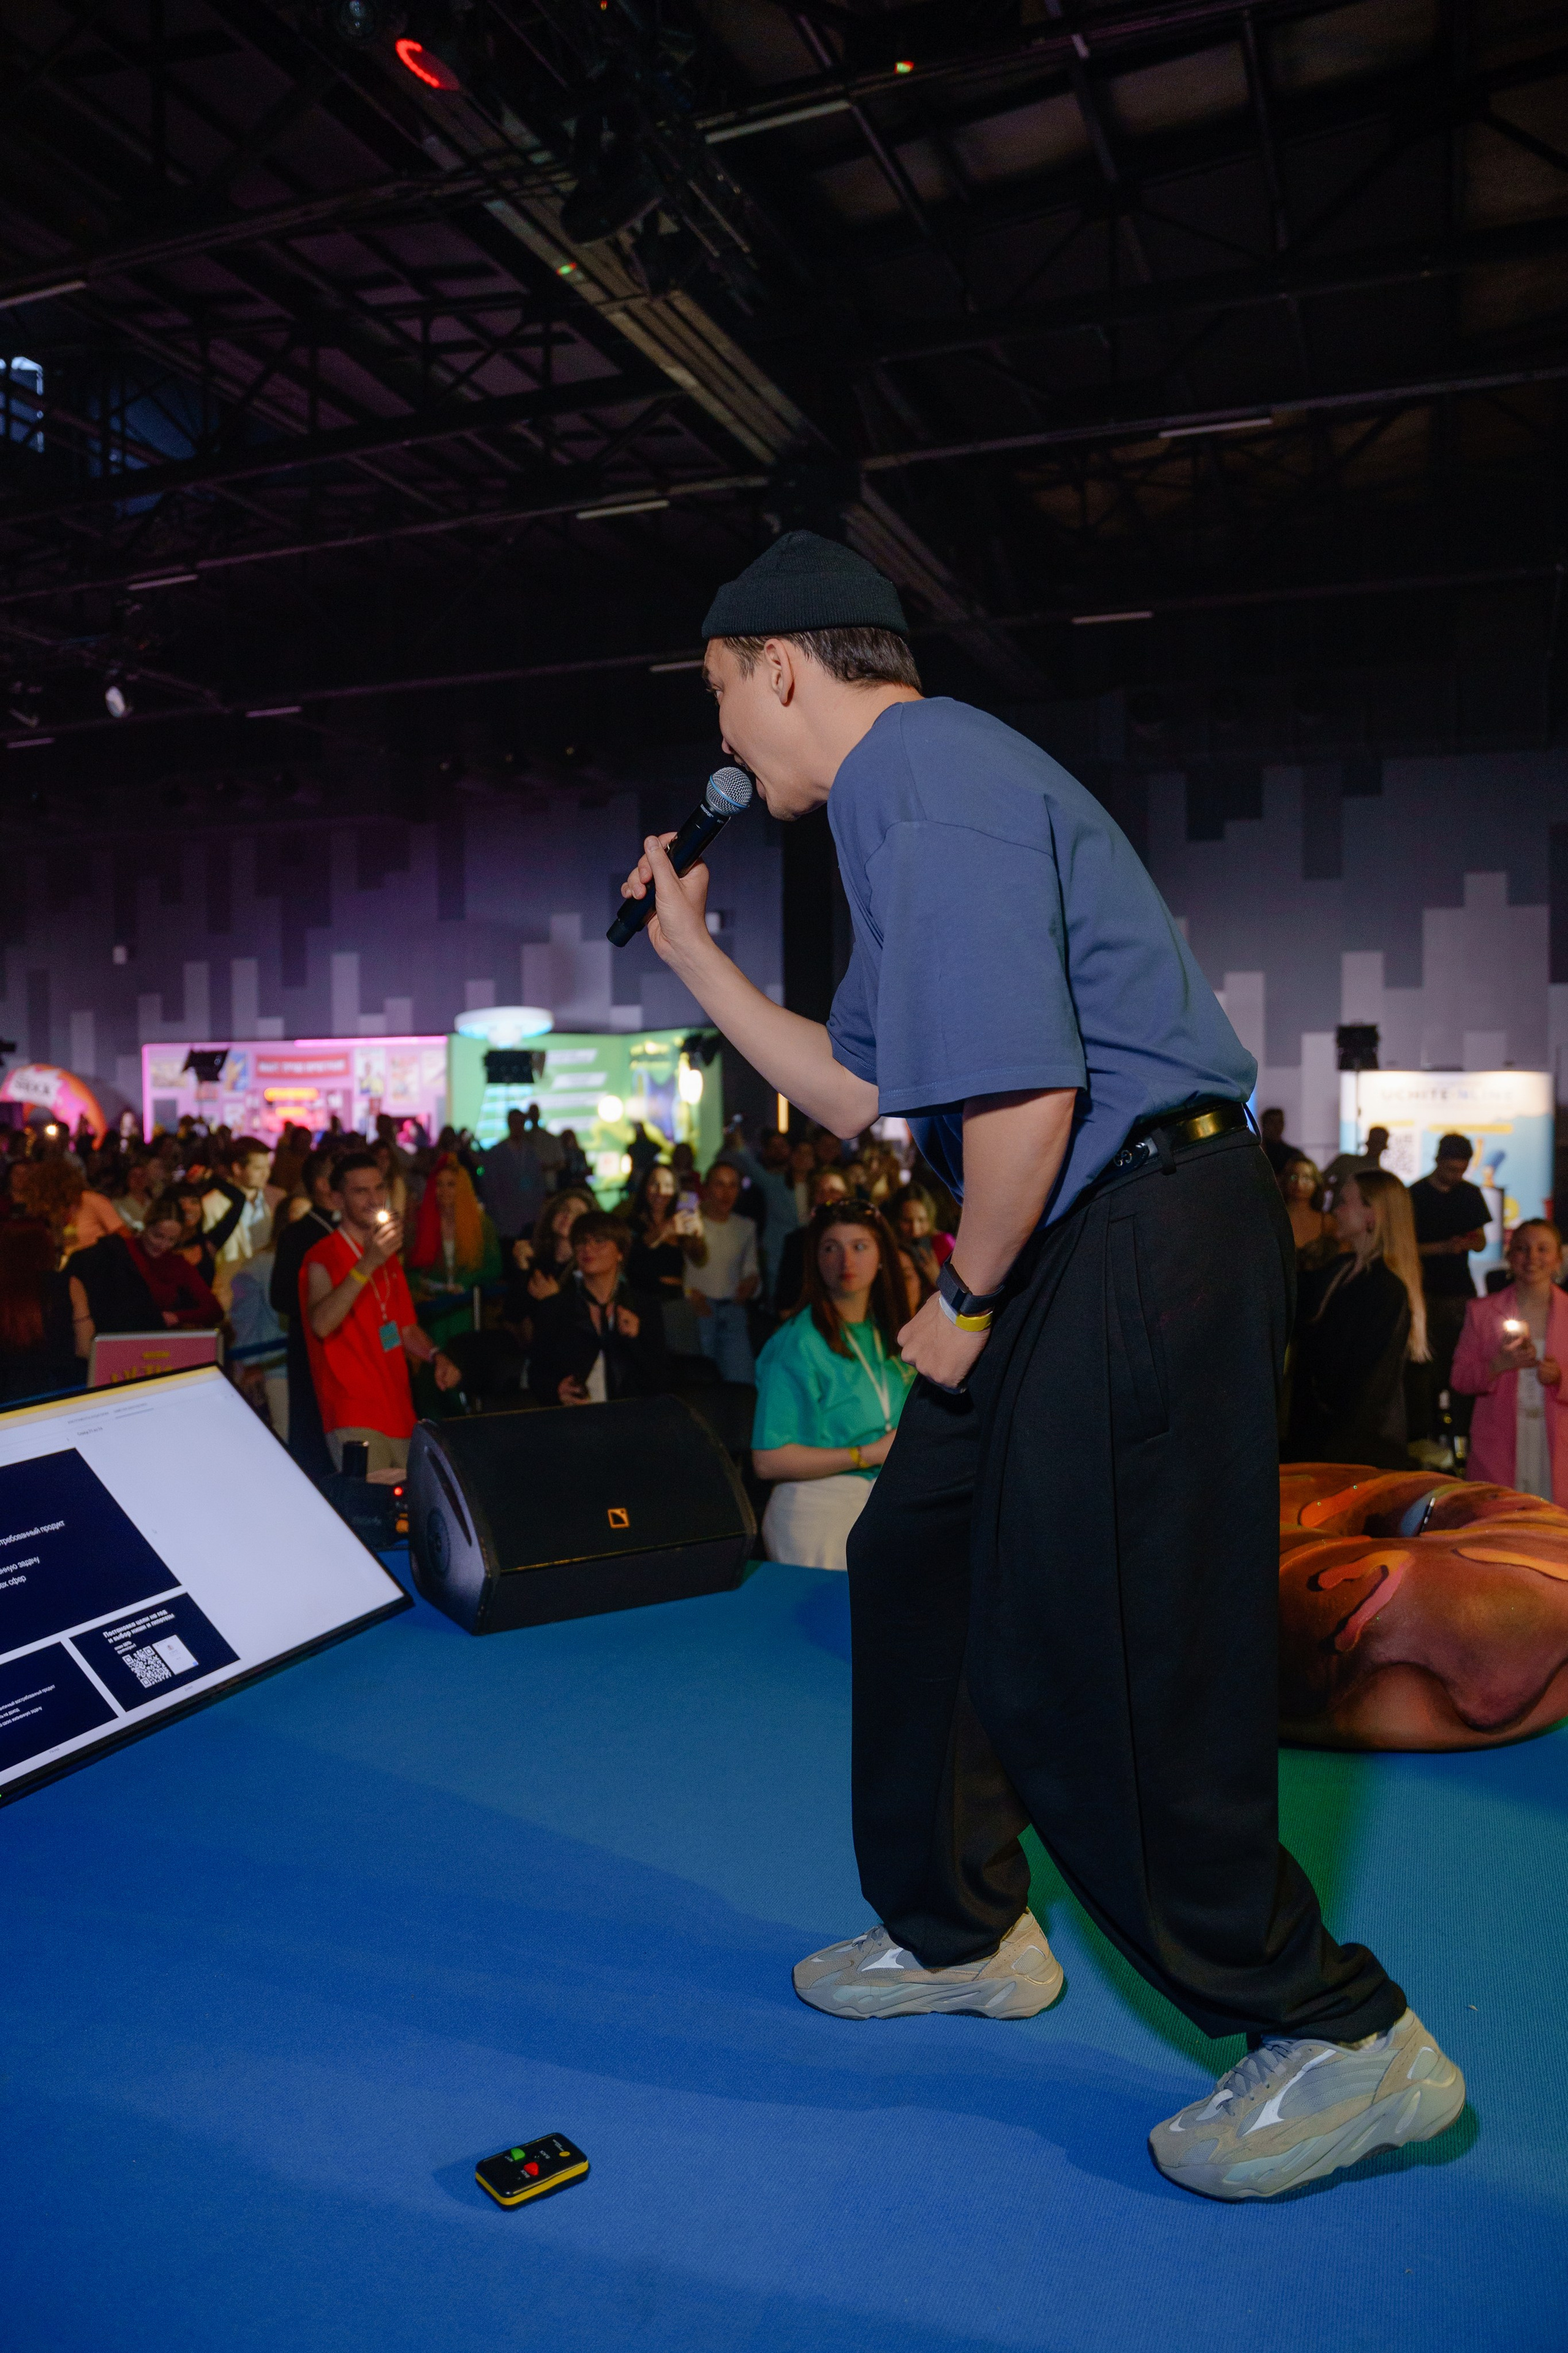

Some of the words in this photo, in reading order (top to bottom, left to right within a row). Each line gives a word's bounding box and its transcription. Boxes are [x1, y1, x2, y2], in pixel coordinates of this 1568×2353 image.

[0, 1527, 40, 1546] требованный
[40, 1520, 65, 1533] продукт
[17, 1556, 40, 1568] задачу
[8, 1575, 27, 1585] сфер
[102, 1622, 136, 1638] Постановка
[135, 1616, 151, 1626] цели
[113, 1630, 132, 1642] выбор
[151, 1613, 175, 1626] гипотезы
